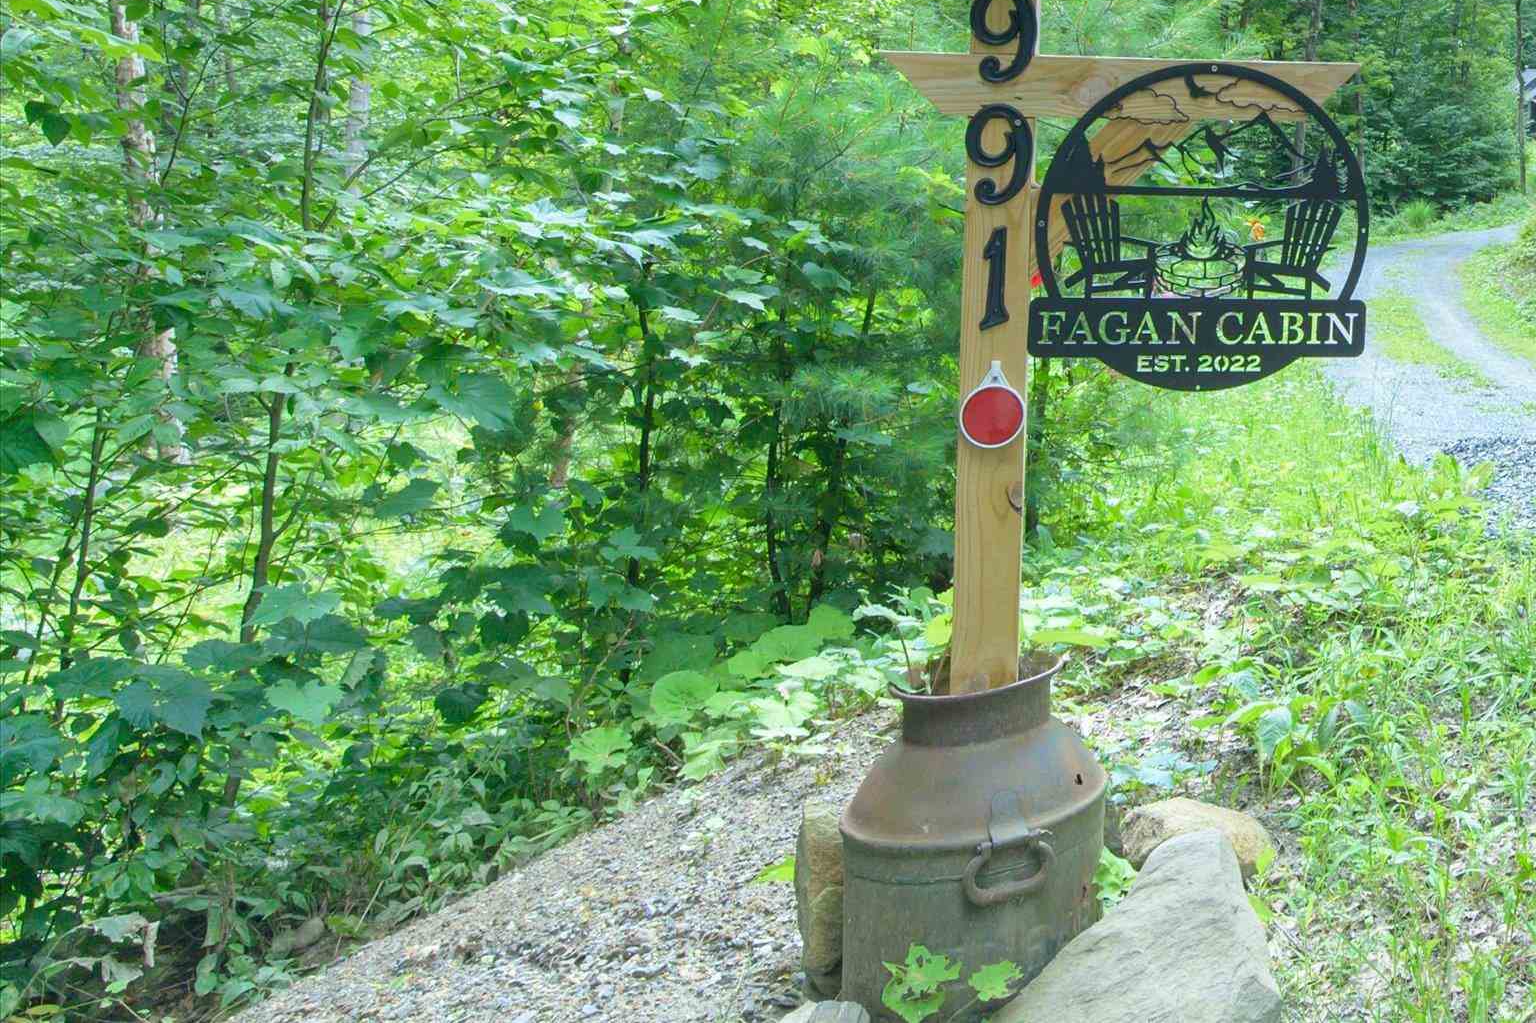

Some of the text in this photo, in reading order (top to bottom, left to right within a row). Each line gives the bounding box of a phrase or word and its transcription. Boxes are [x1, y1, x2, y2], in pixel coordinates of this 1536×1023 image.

[1037, 310, 1359, 346] FAGAN CABIN
[1136, 354, 1262, 373] EST. 2022
